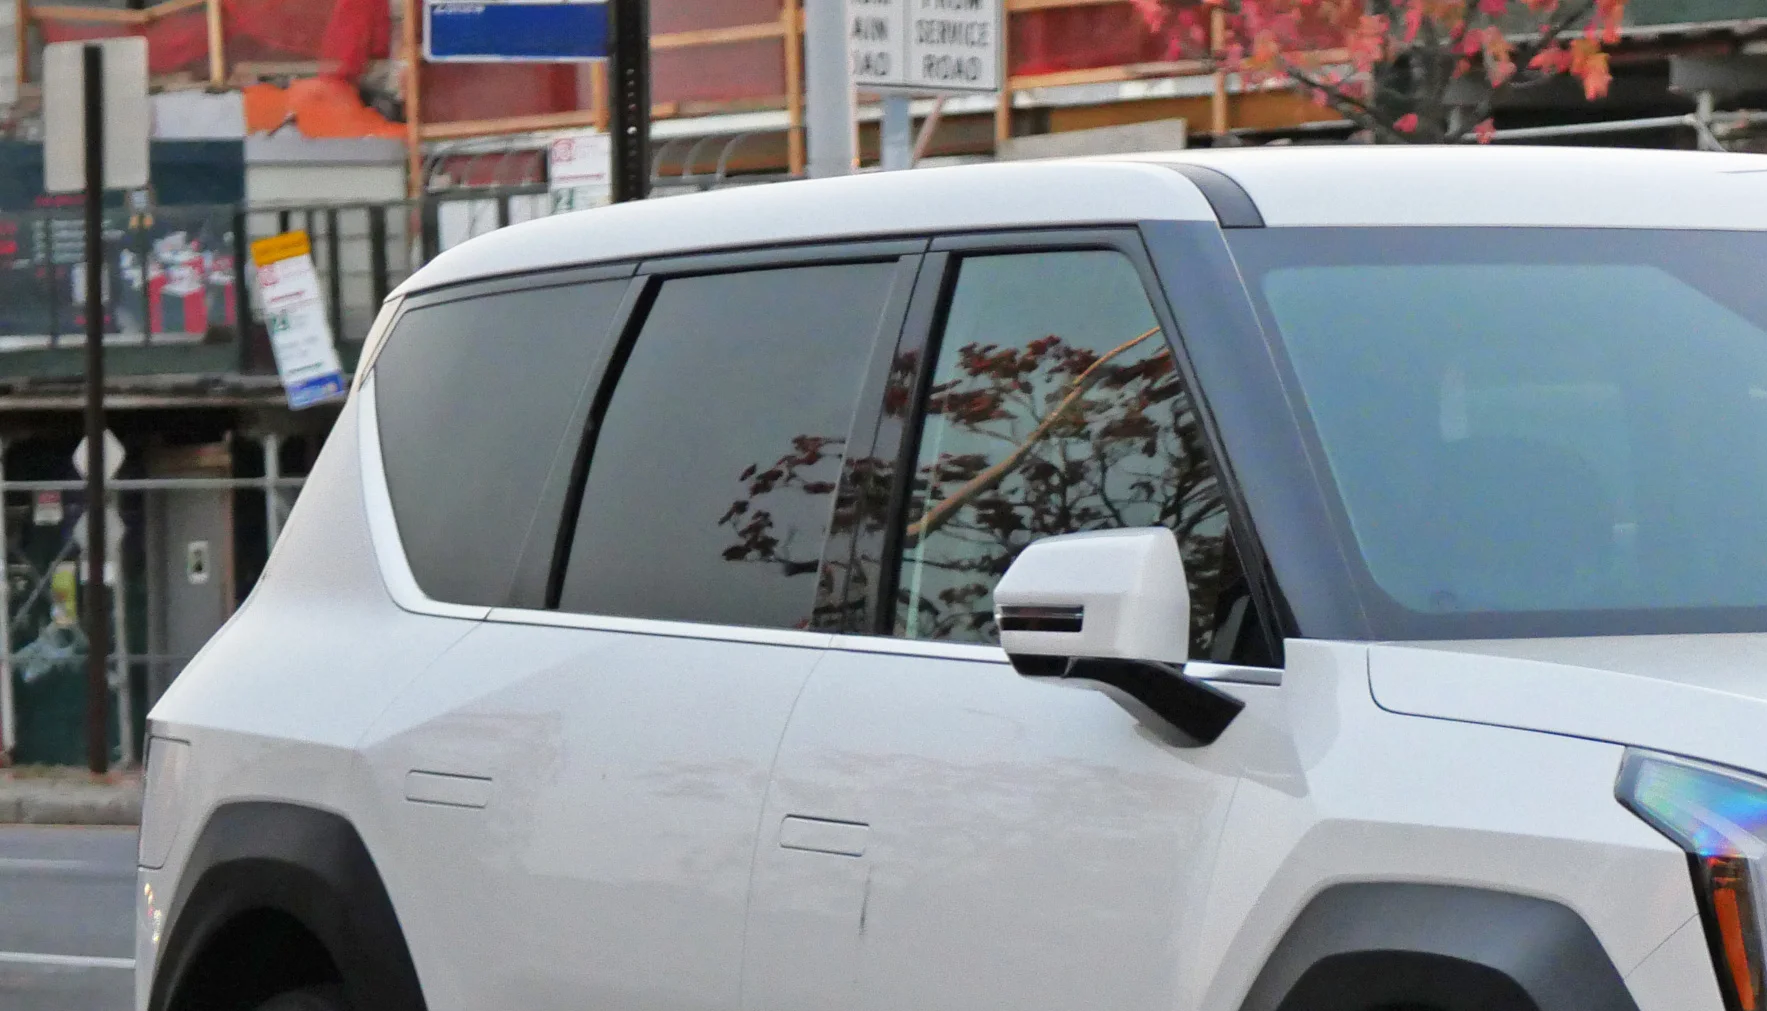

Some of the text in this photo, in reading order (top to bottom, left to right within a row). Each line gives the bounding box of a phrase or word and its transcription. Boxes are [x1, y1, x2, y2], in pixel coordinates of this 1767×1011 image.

[852, 17, 888, 40] AIN
[916, 19, 989, 46] SERVICE
[922, 53, 982, 80] ROAD
